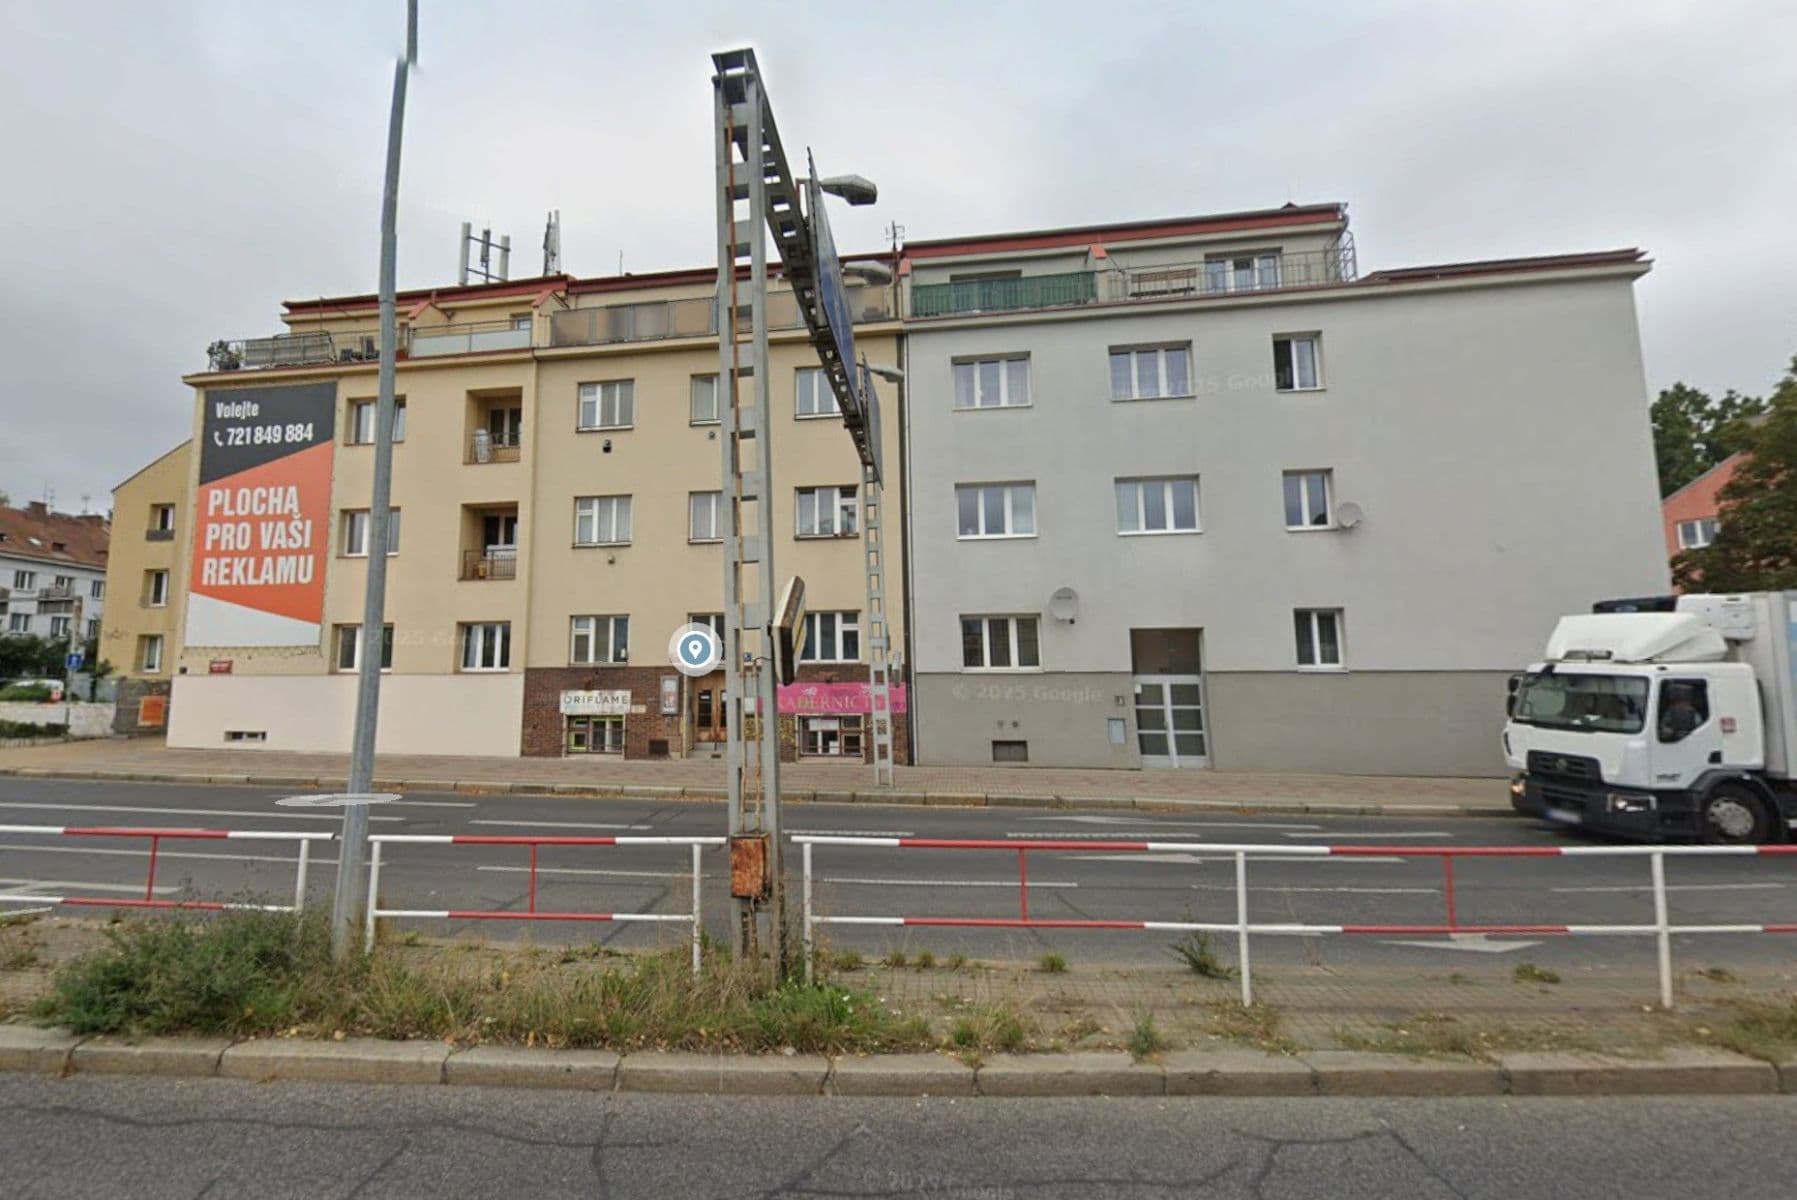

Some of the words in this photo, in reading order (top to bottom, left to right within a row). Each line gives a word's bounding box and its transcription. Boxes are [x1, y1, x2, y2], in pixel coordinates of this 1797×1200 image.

[216, 401, 259, 419] Volejte
[227, 427, 250, 446] 721
[254, 425, 282, 445] 849
[285, 423, 313, 443] 884
[208, 486, 299, 517] PLOCHA
[205, 521, 251, 551] PRO
[260, 512, 312, 550] VAŠI
[202, 555, 315, 586] REKLAMU
[564, 695, 629, 705] ORIFLAME
